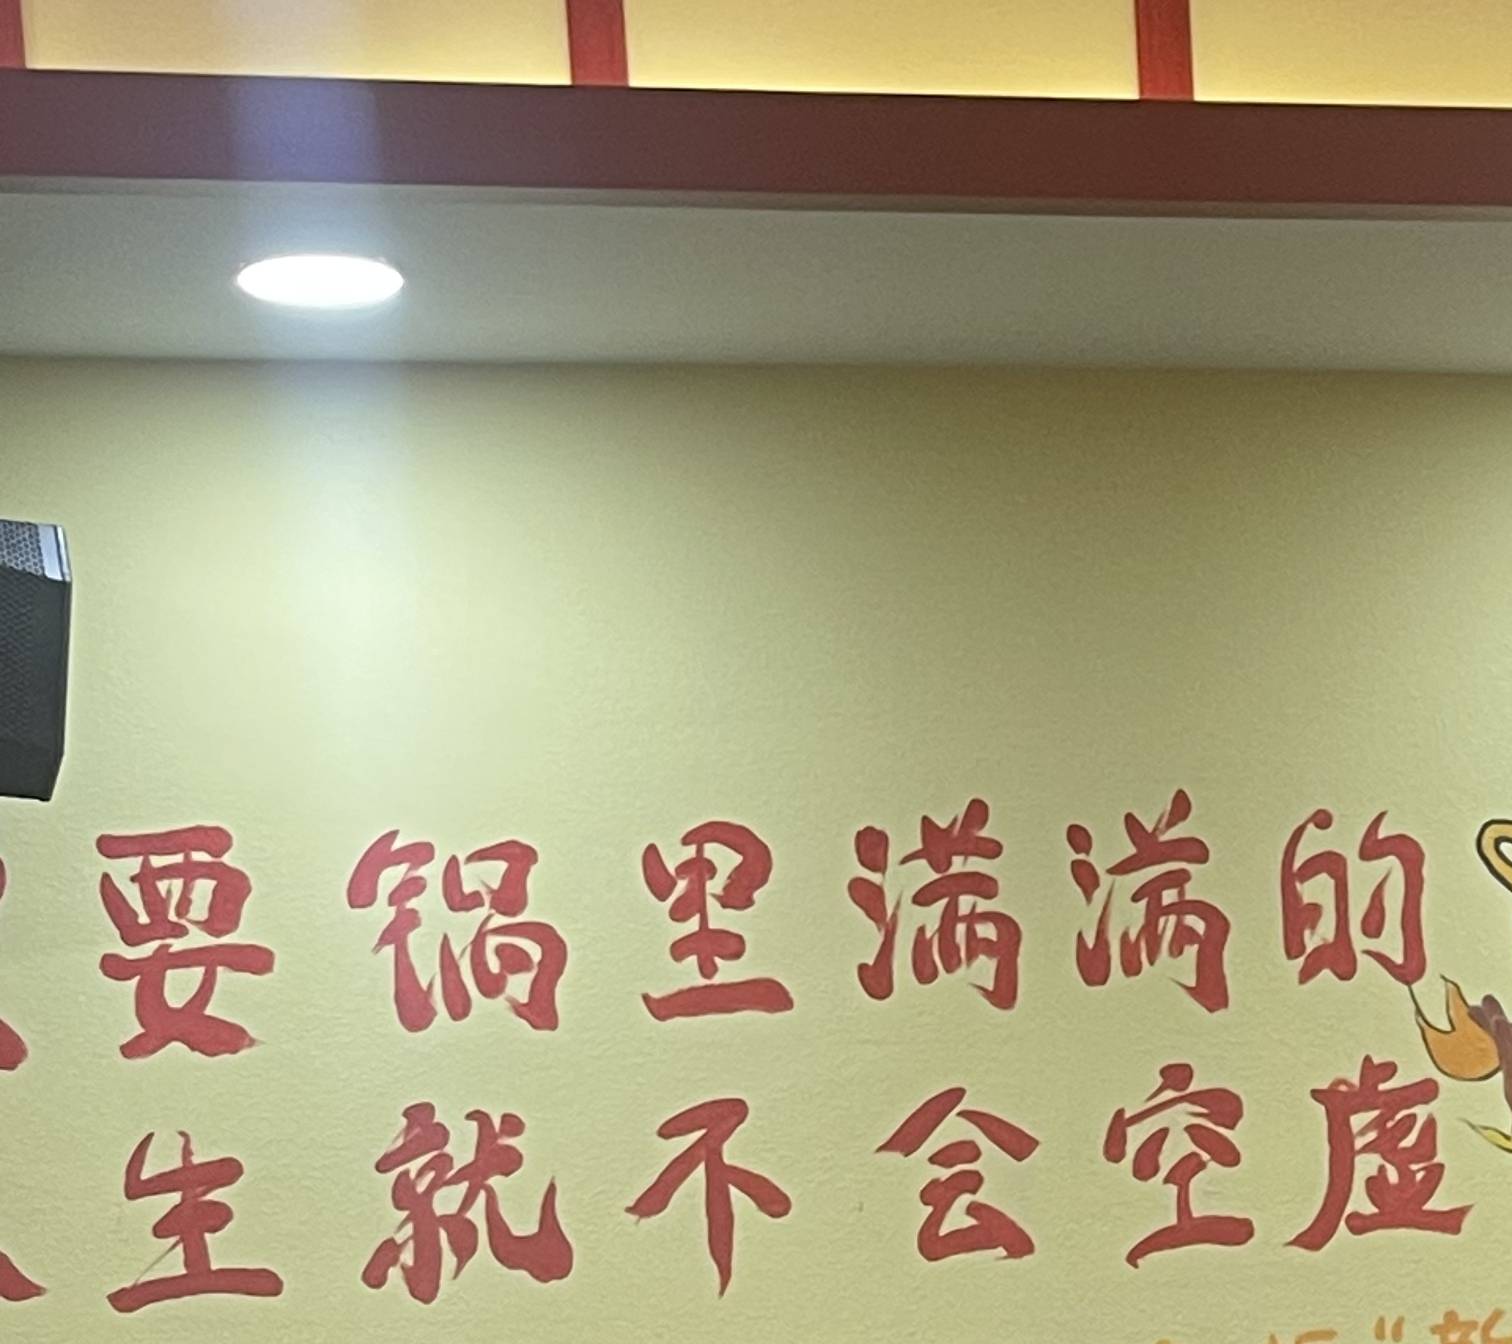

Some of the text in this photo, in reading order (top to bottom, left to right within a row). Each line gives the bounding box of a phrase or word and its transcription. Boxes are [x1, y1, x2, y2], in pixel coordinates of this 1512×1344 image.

[0, 787, 1427, 1071] 要锅里满满的
[0, 1053, 1475, 1313] 生就不会空虚
